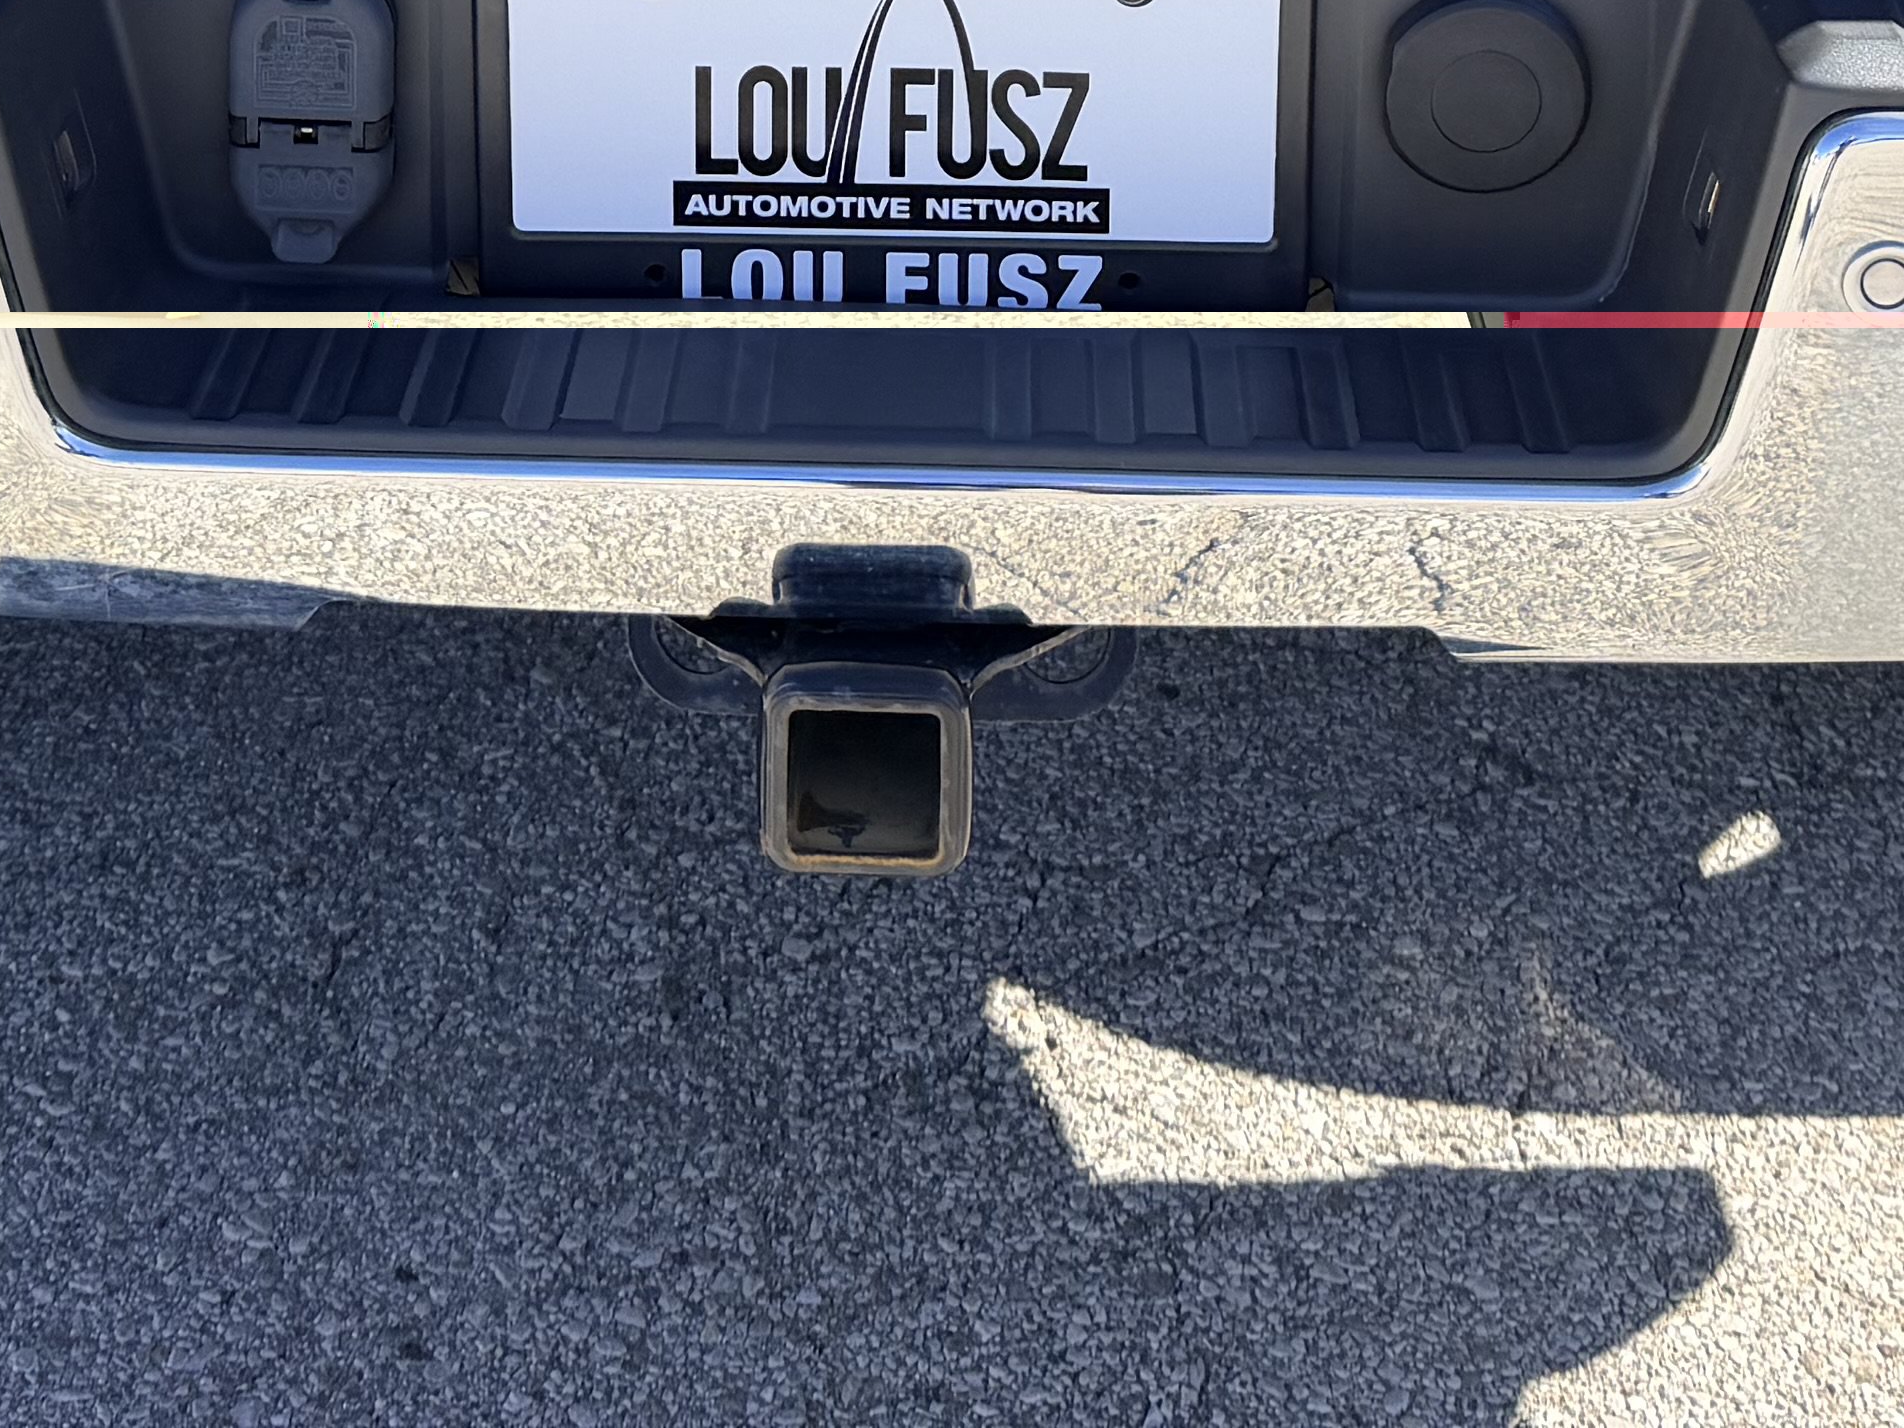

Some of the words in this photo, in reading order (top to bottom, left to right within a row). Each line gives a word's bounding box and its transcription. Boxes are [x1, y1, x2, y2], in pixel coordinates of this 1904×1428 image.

[695, 64, 843, 178] LOU
[889, 66, 1090, 182] FUSZ
[684, 193, 911, 221] AUTOMOTIVE
[925, 197, 1101, 225] NETWORK
[885, 251, 1103, 311] FUSZ
